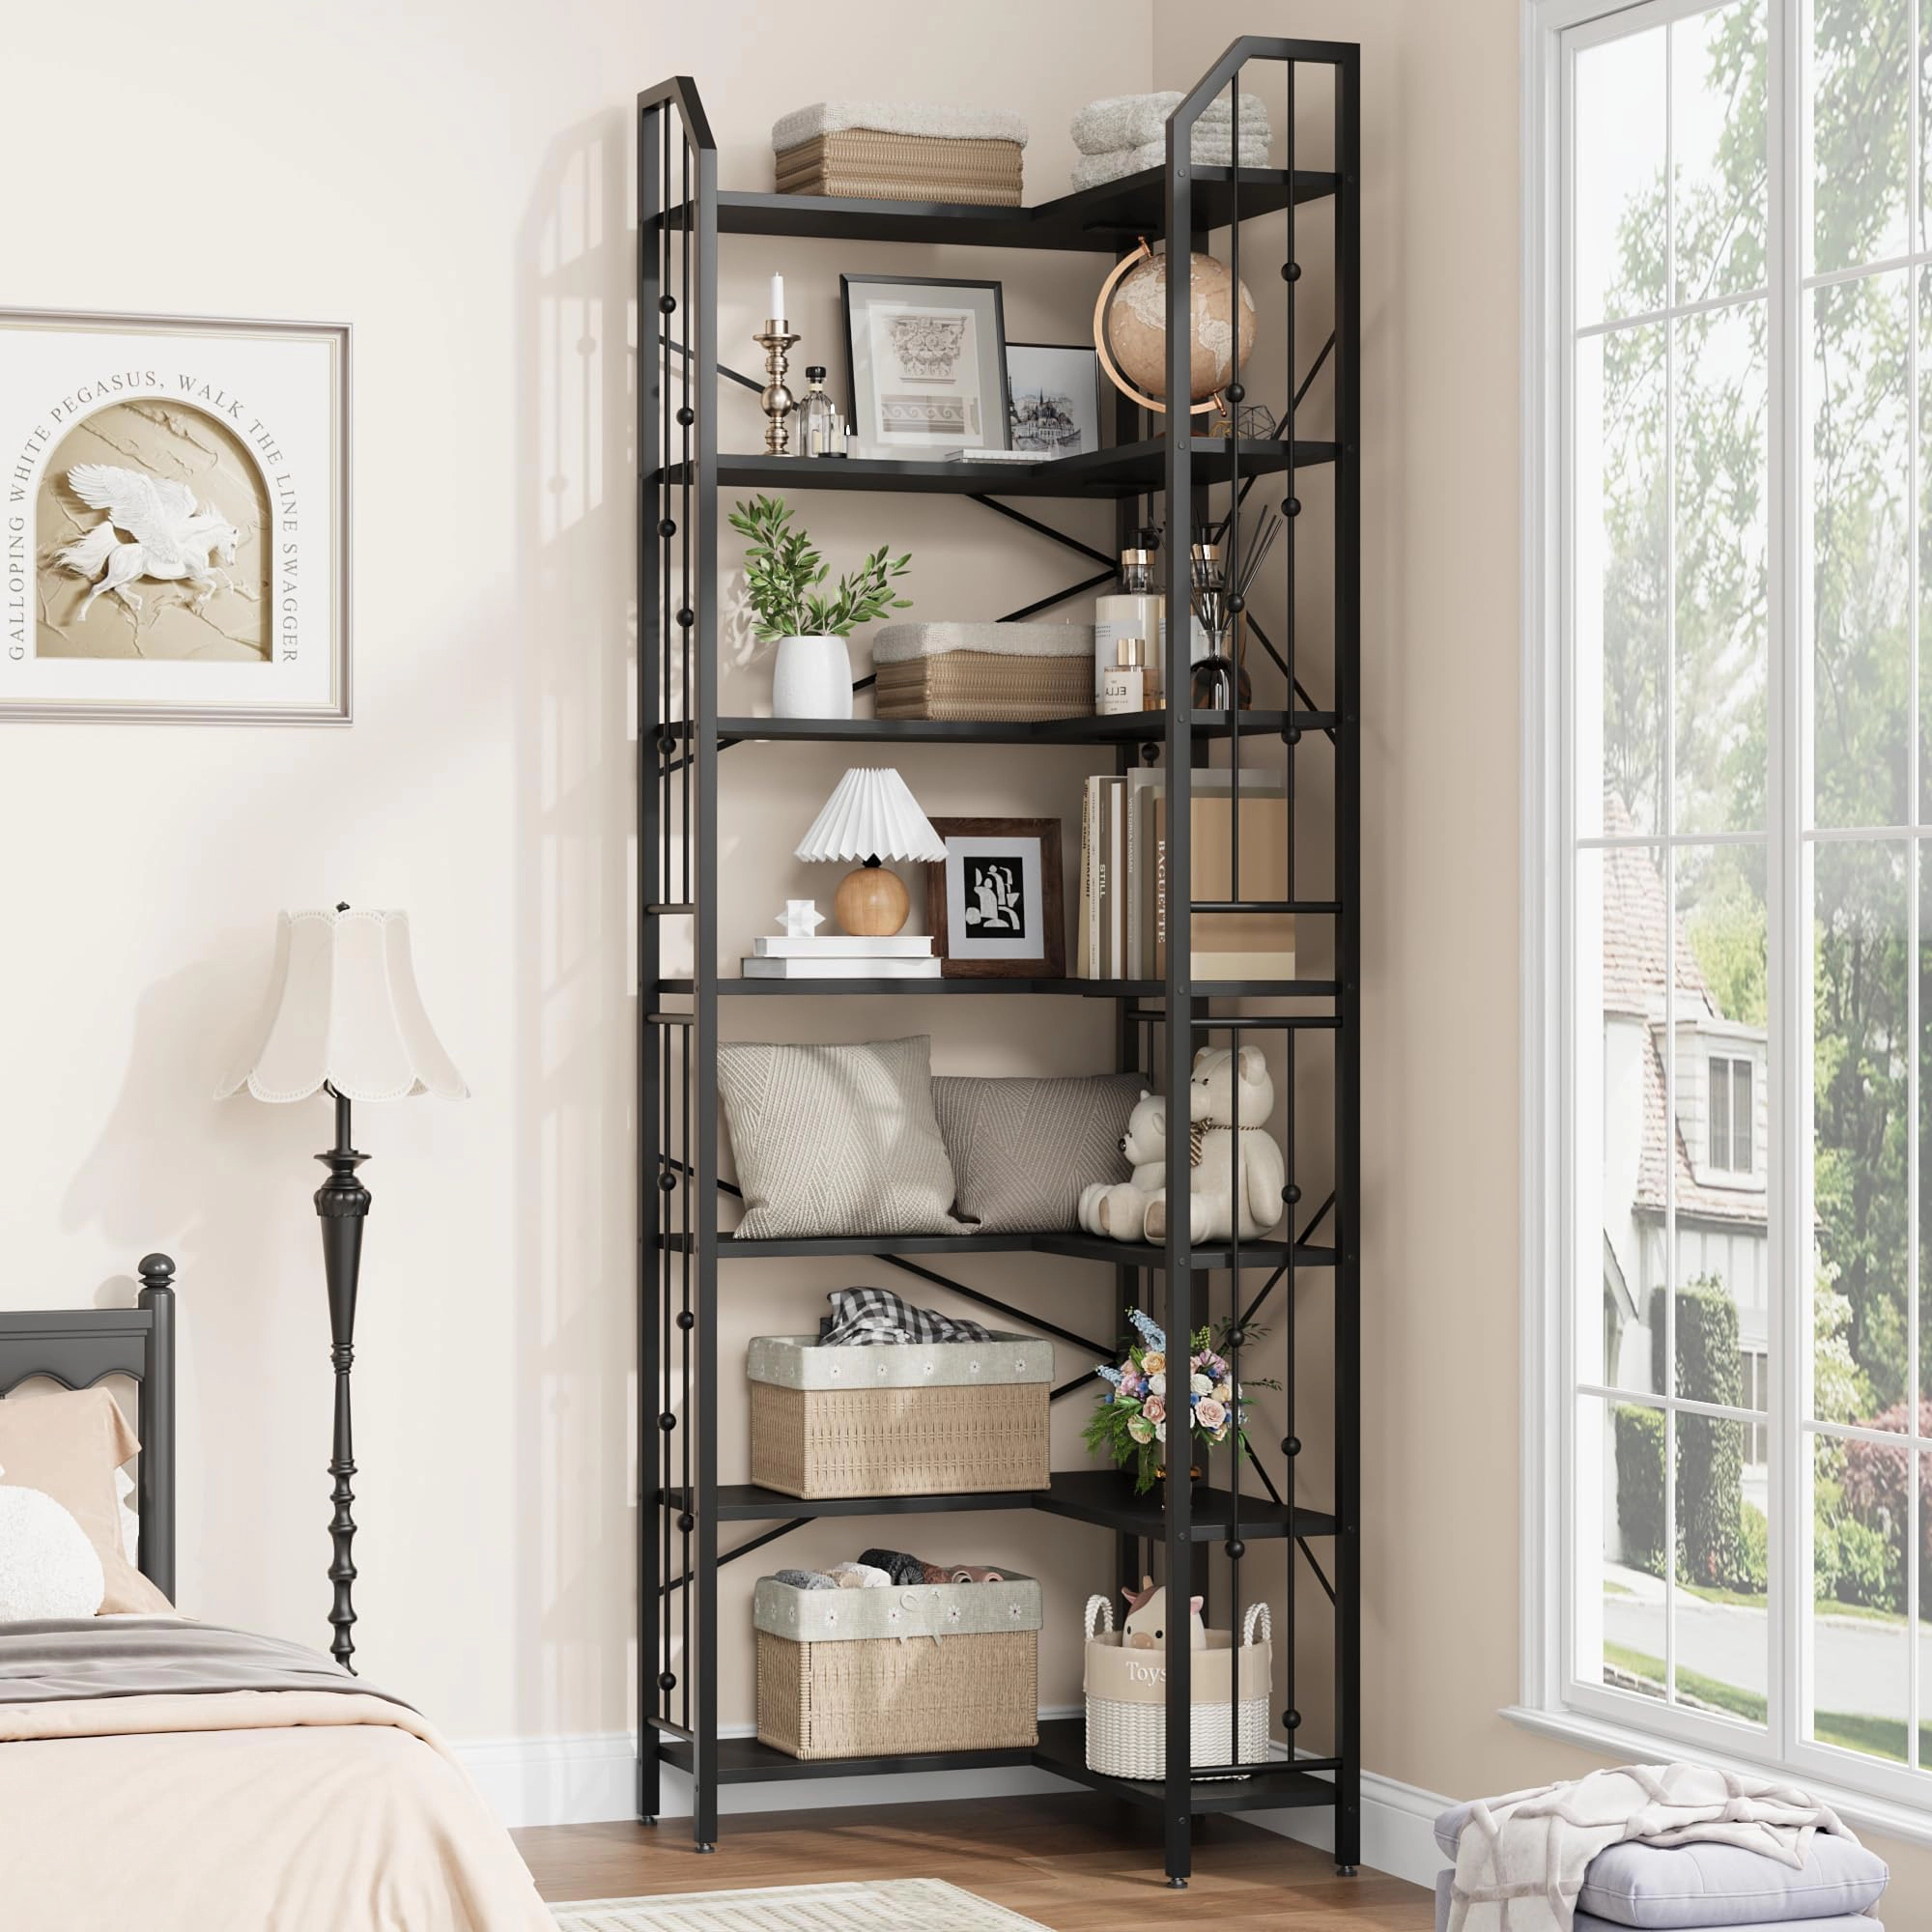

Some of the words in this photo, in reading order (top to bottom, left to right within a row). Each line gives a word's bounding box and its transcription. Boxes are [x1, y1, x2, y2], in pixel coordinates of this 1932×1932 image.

[50, 370, 165, 424] PEGASUS,
[178, 373, 245, 420] WALK
[10, 425, 52, 503] WHITE
[248, 418, 285, 466] THE
[276, 473, 298, 532] LINE
[9, 516, 25, 661] GALLOPING
[282, 543, 298, 663] SWAGGER
